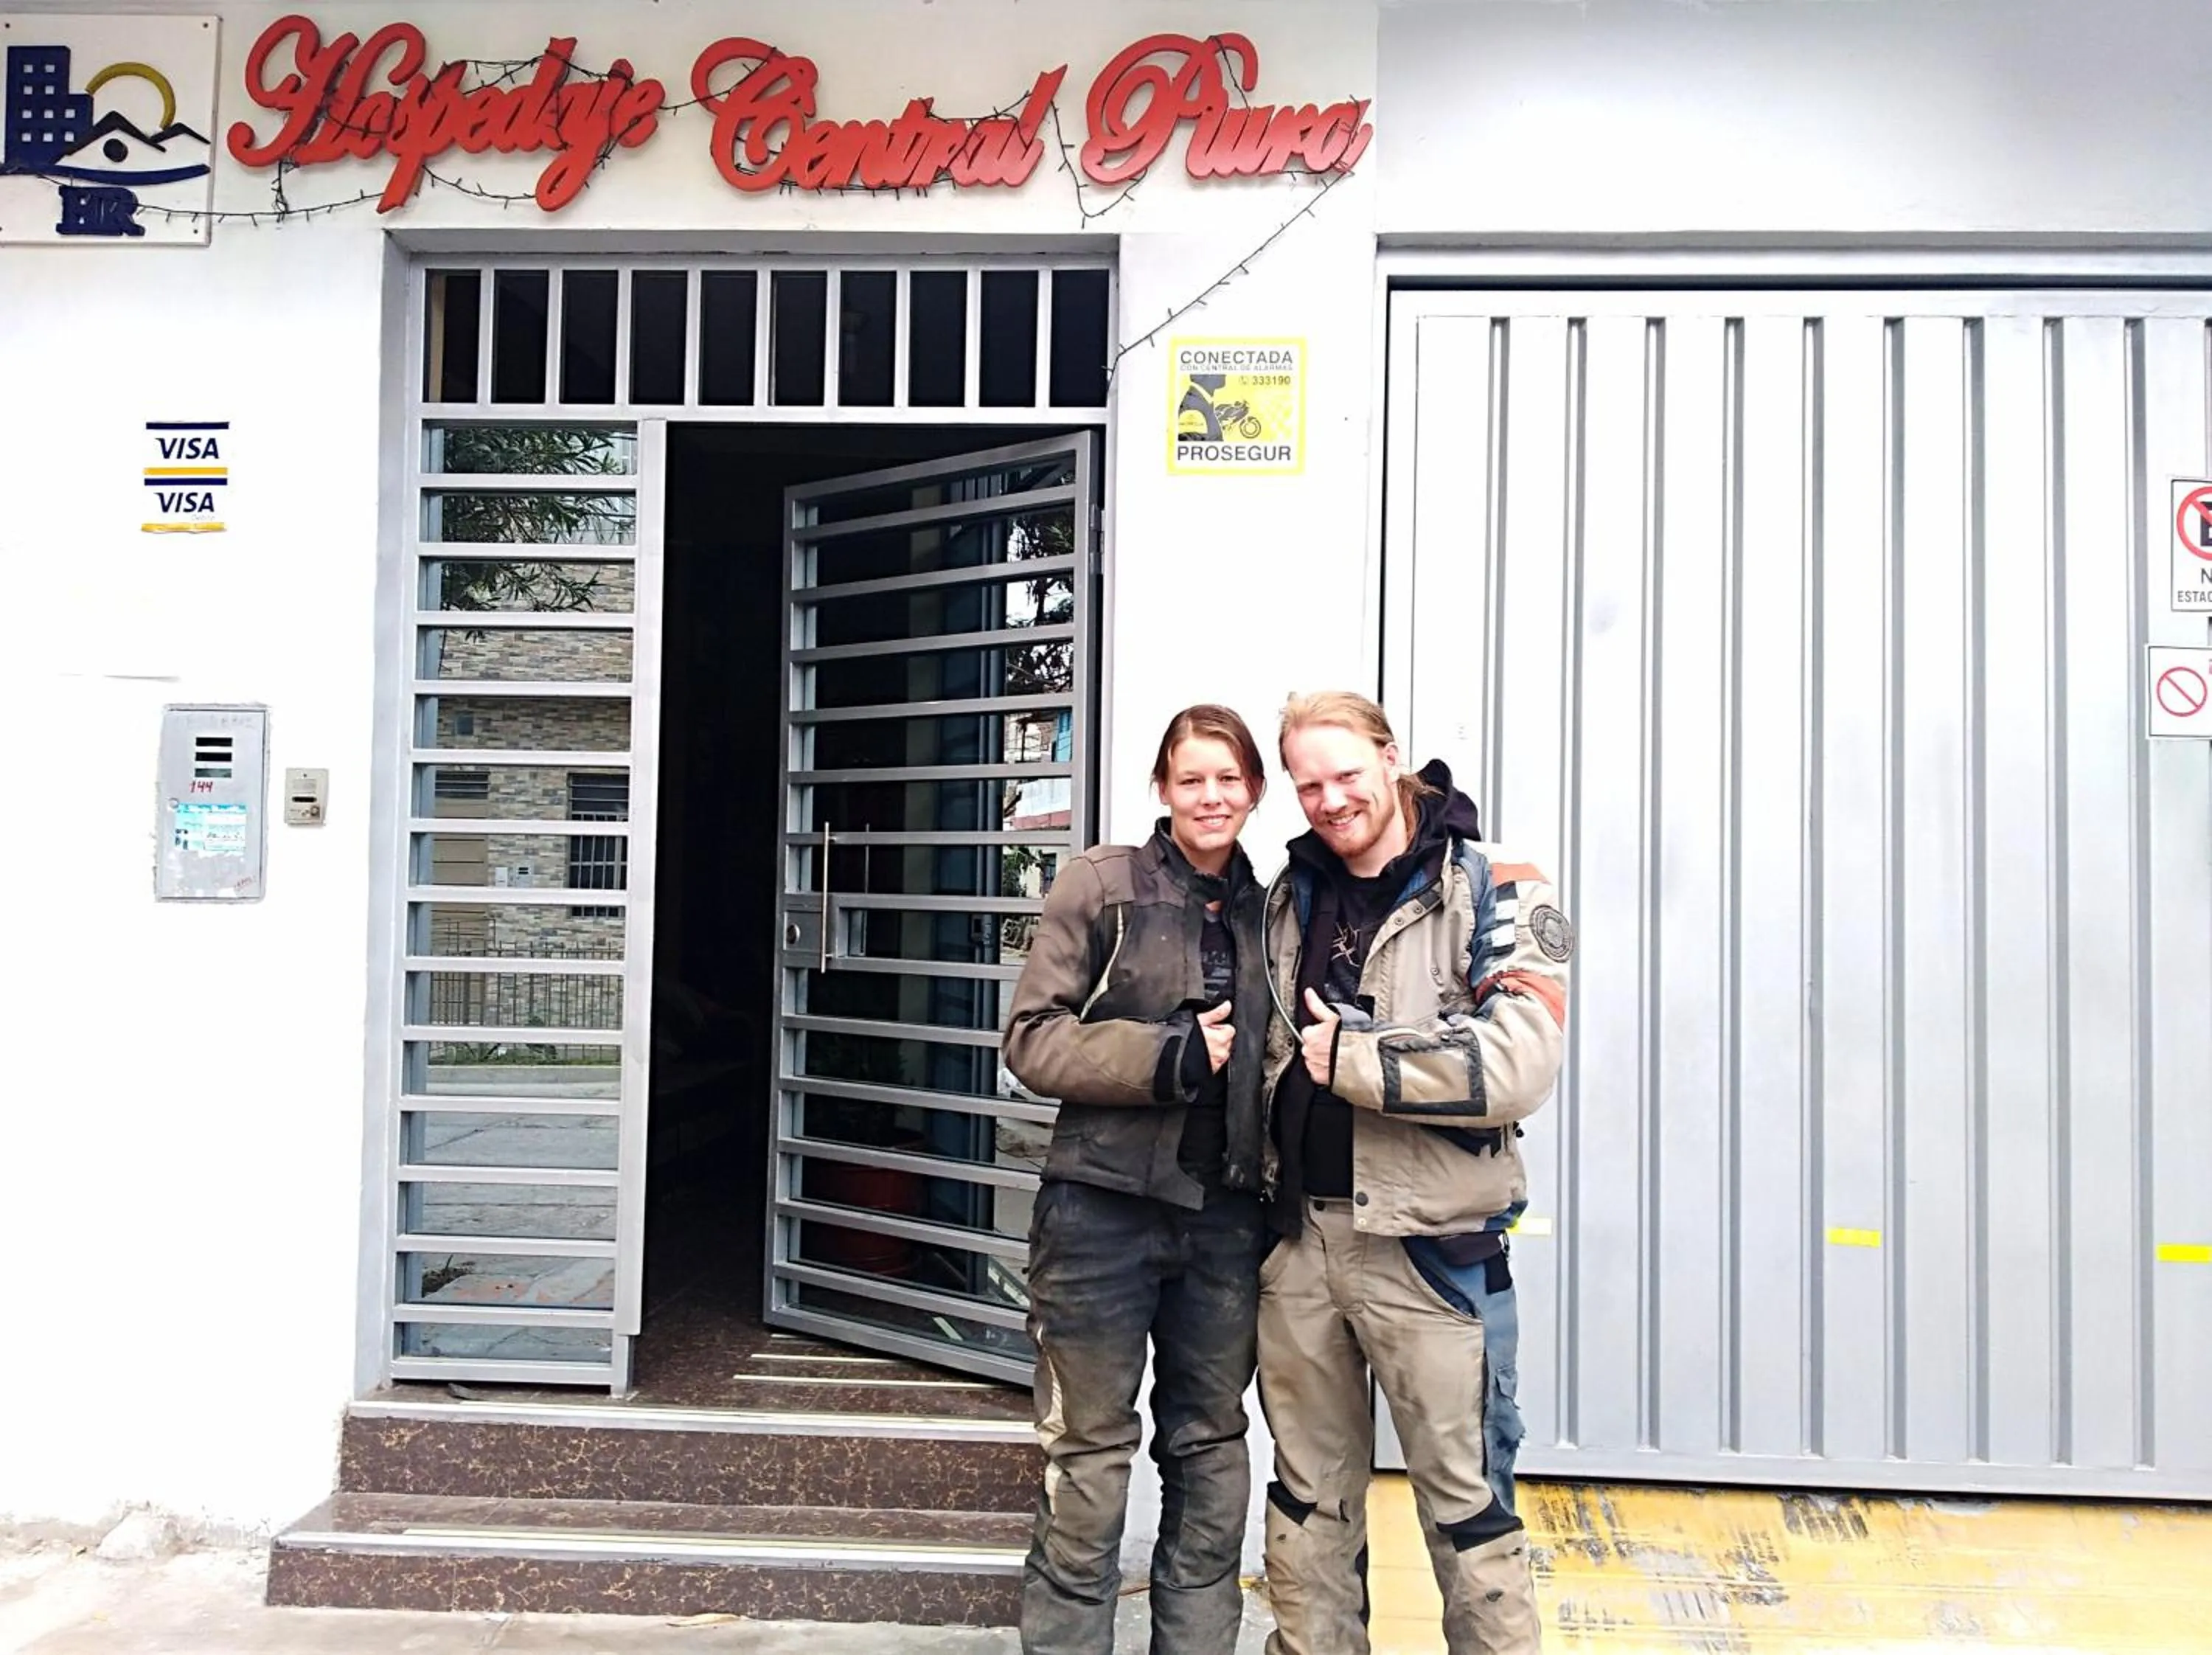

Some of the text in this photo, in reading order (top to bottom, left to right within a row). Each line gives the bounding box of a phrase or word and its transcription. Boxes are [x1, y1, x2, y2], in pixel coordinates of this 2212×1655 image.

[227, 15, 1373, 212] Hospedaje Central Piura
[1180, 350, 1293, 364] CONECTADA
[1253, 375, 1291, 386] 333190
[155, 437, 220, 459] VISA
[1177, 445, 1292, 462] PROSEGUR
[153, 492, 215, 513] VISA
[189, 780, 213, 794] 144
